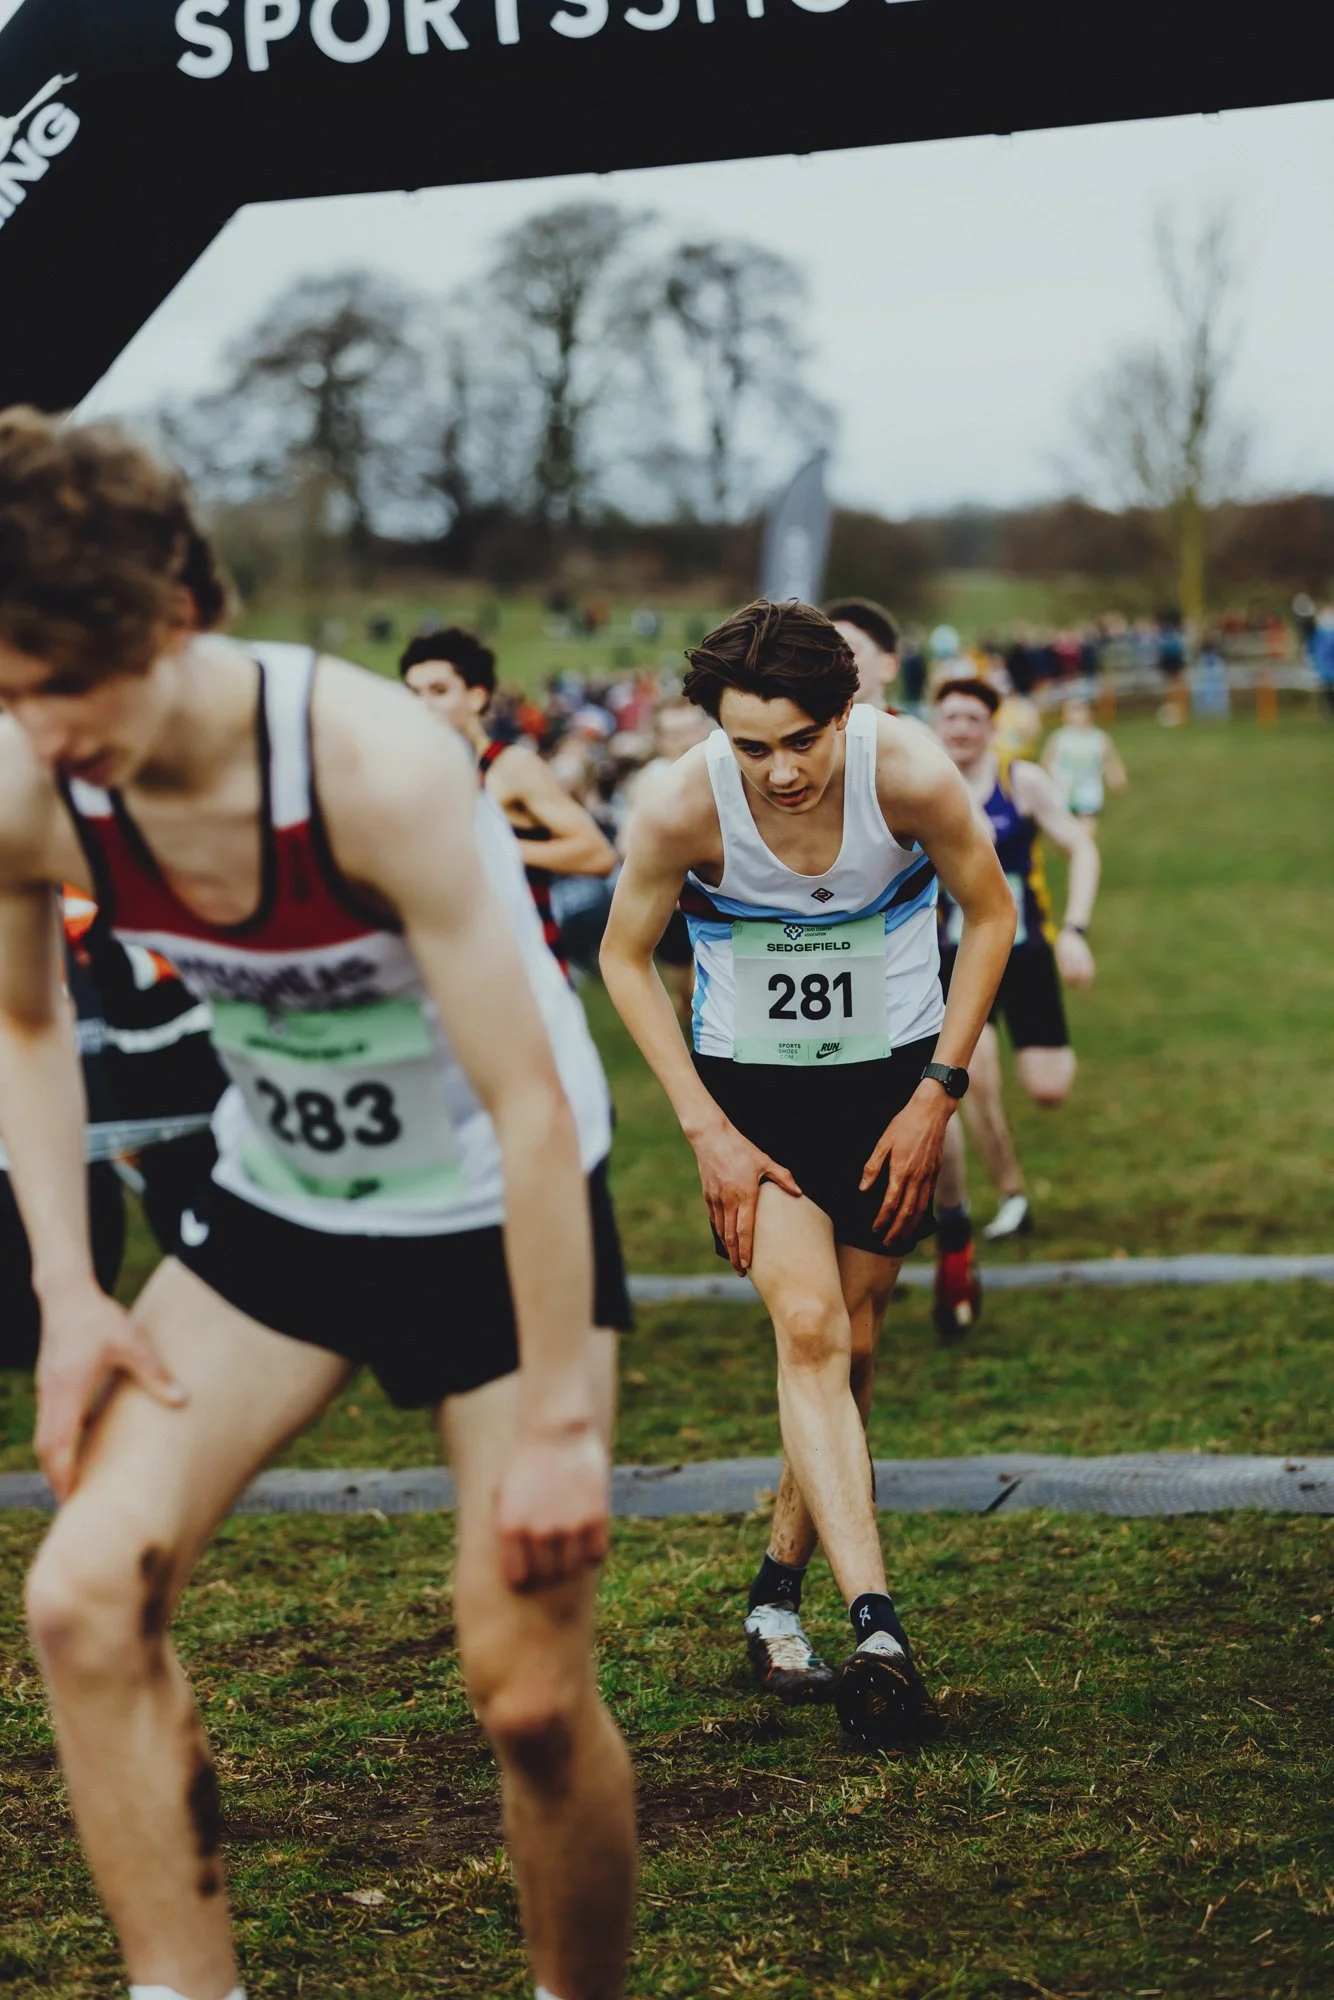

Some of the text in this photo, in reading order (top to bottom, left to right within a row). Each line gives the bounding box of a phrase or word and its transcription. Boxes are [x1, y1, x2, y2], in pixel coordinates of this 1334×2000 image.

[767, 942, 851, 952] SEDGEFIELD
[768, 971, 852, 1020] 281
[820, 1042, 840, 1052] RUN
[255, 1077, 401, 1152] 283
